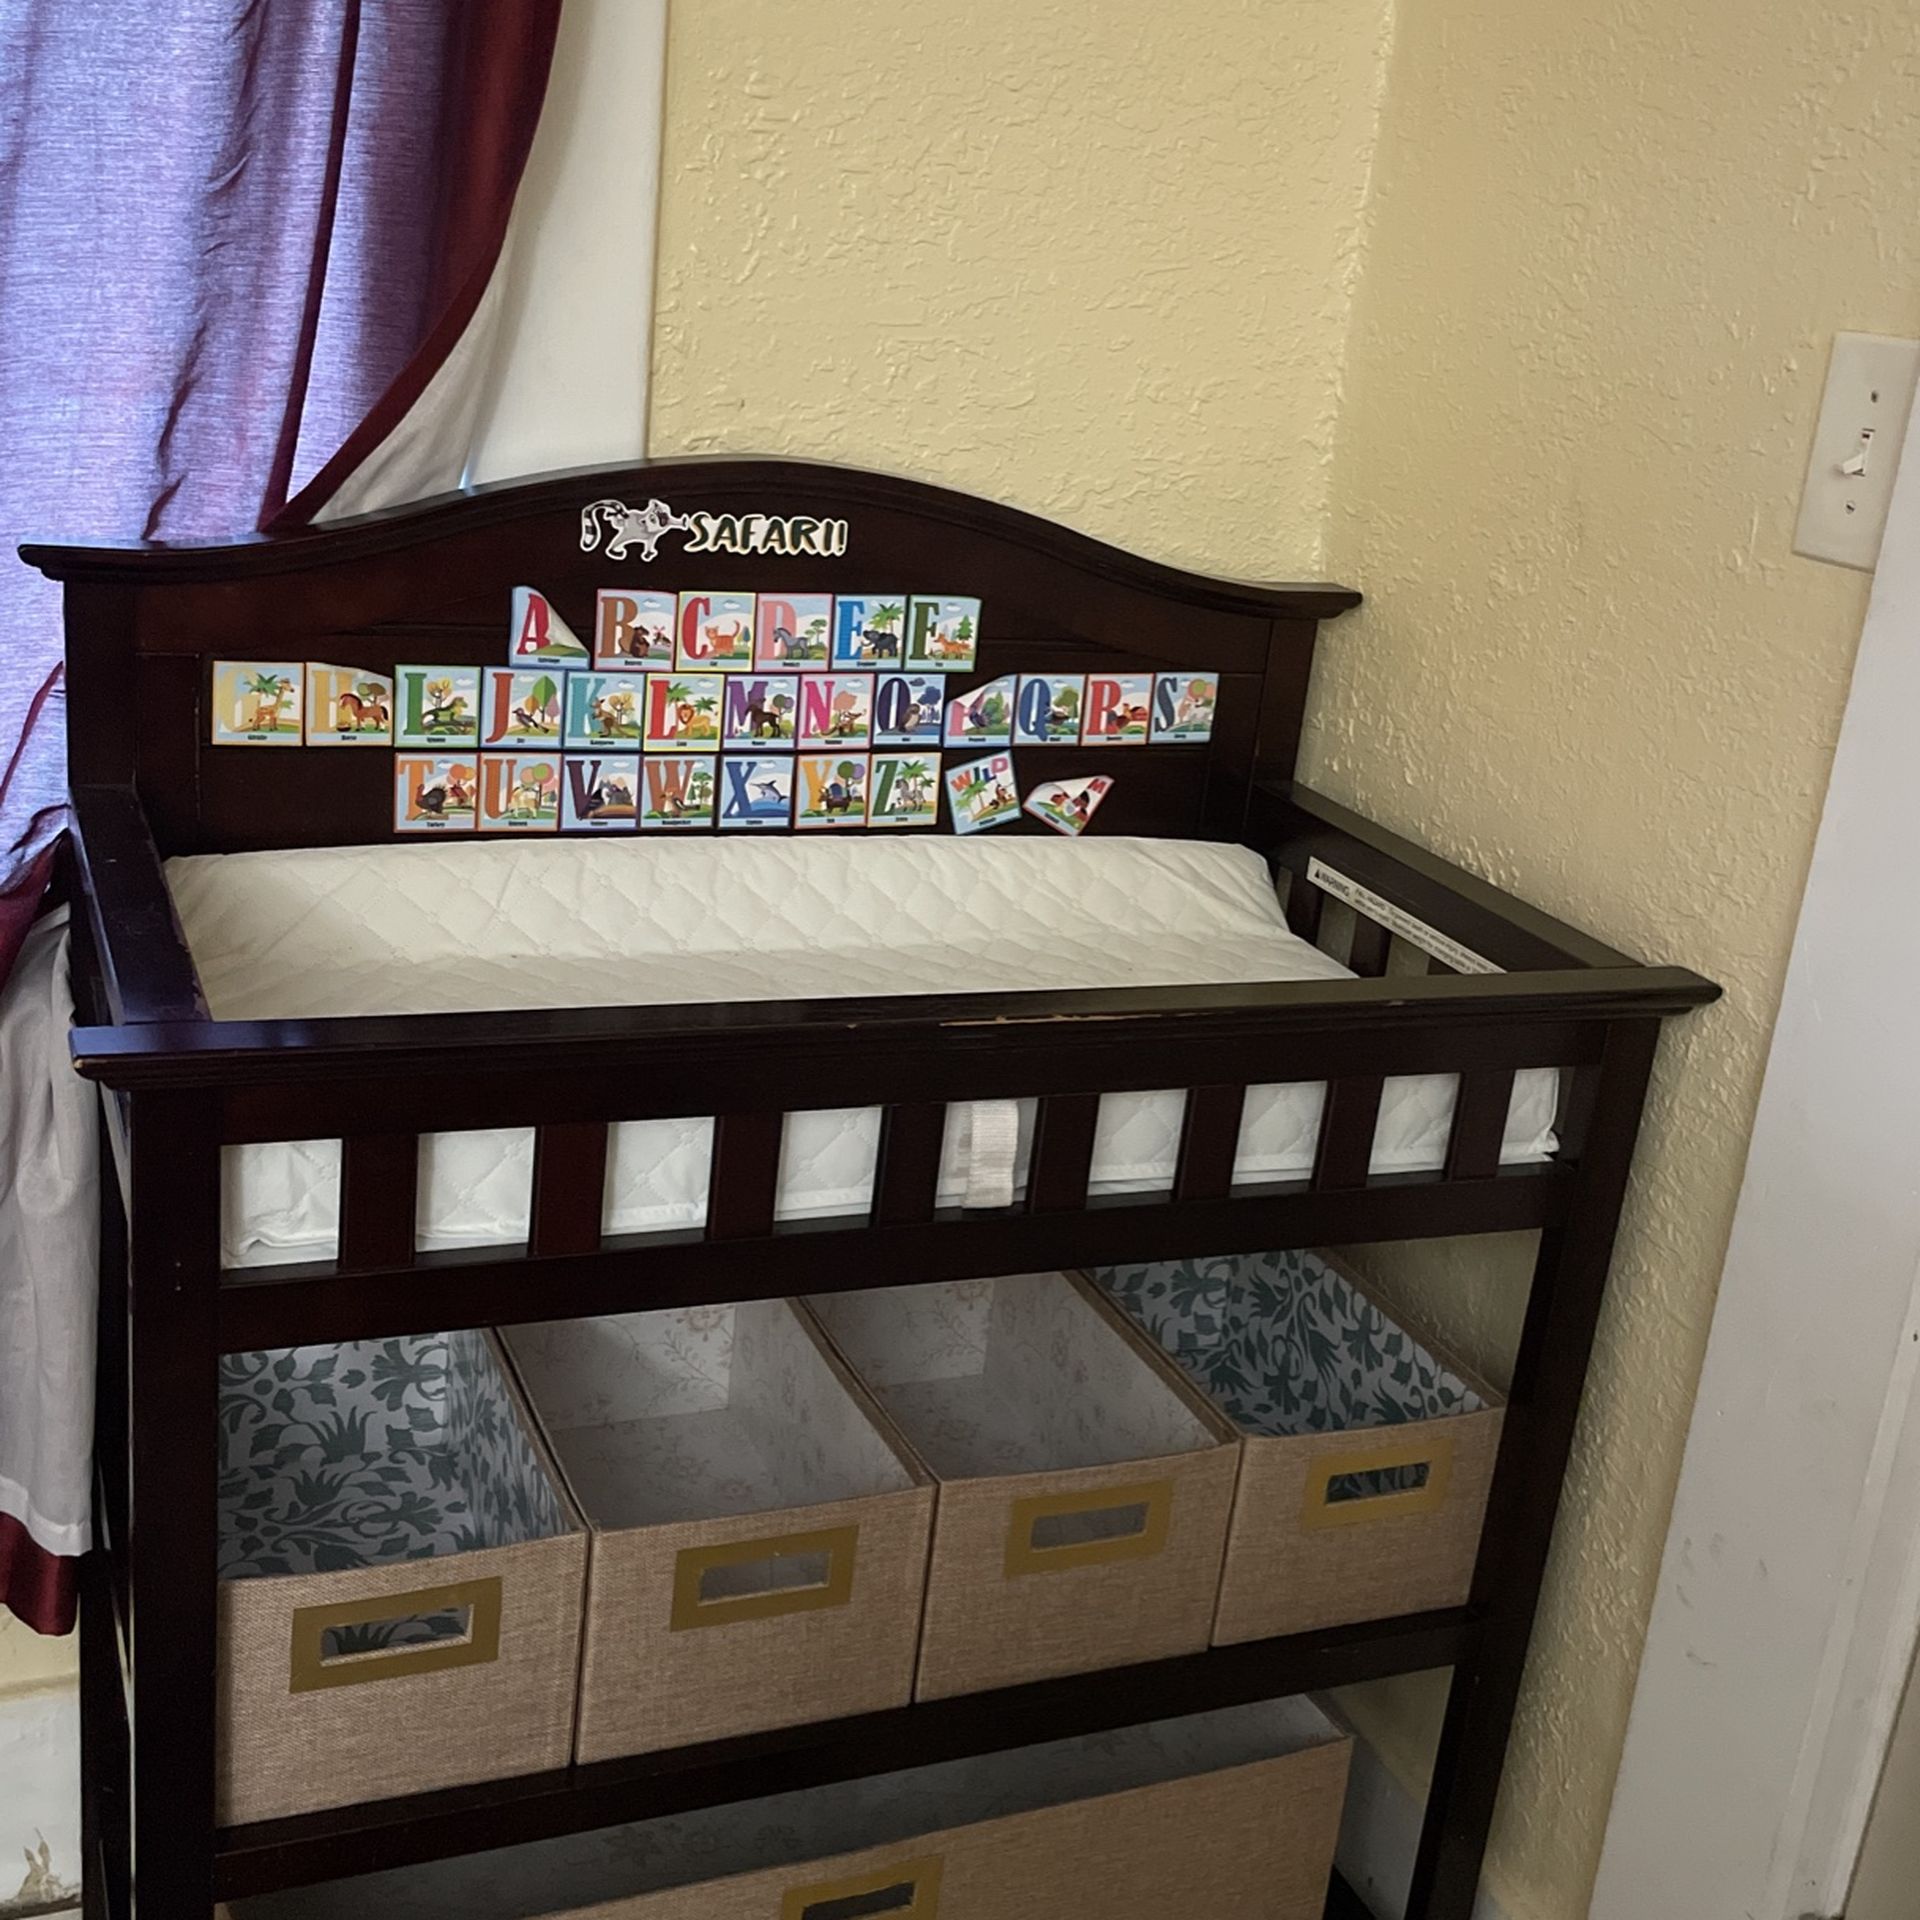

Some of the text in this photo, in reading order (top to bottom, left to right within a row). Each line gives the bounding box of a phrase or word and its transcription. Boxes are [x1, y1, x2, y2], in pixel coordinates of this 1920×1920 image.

[685, 513, 847, 552] SAFARI!
[517, 594, 551, 654] A
[682, 597, 710, 659] C
[758, 601, 797, 660] D
[835, 601, 864, 660] E
[909, 602, 940, 659] F
[403, 673, 427, 735] I
[485, 673, 514, 743] J
[568, 678, 606, 738] K
[647, 680, 678, 739] L
[725, 681, 768, 738] M
[801, 681, 835, 738] N
[1019, 679, 1052, 742] Q
[1086, 680, 1122, 735] R
[1155, 677, 1178, 733] S
[398, 760, 434, 821] T
[484, 759, 517, 819] U
[566, 760, 601, 820] V
[644, 760, 695, 818] W
[722, 762, 757, 818] X
[872, 760, 900, 816] Z
[951, 757, 1008, 793] WILD
